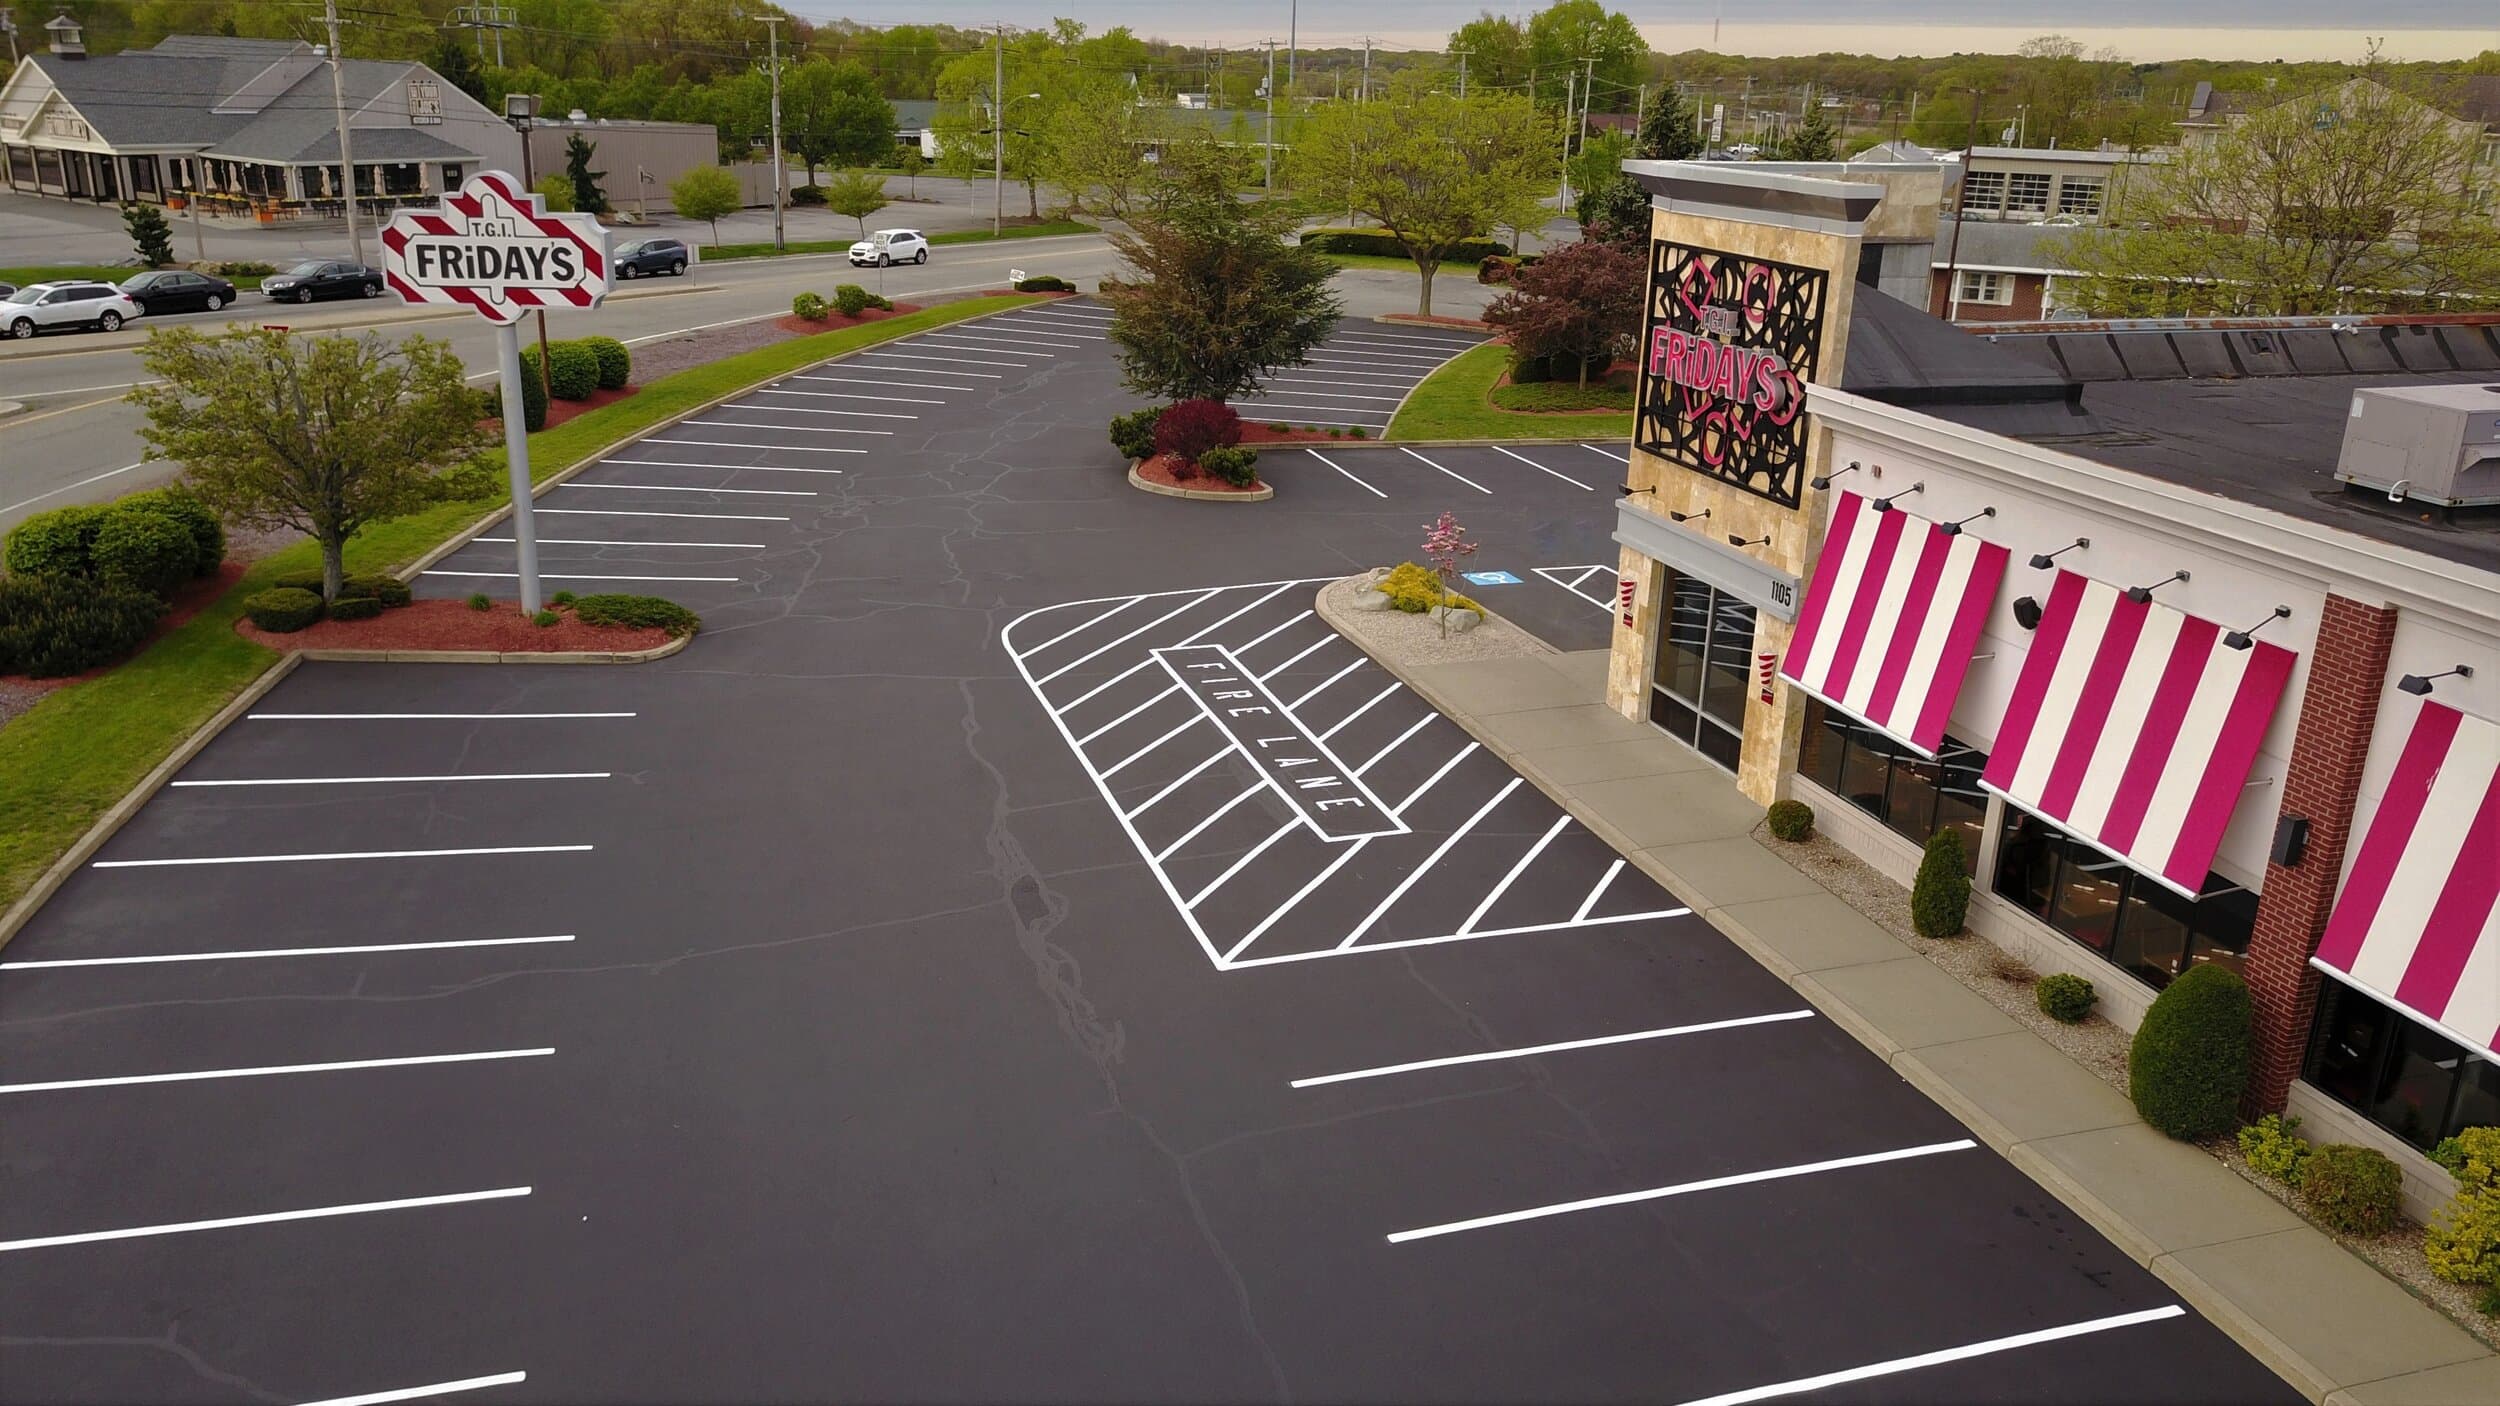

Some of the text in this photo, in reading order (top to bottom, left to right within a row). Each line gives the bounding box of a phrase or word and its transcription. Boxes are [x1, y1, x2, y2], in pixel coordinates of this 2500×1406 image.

[471, 222, 512, 238] T.G.I.
[1771, 580, 1792, 607] 1105
[1187, 662, 1366, 811] FIRE LANE
